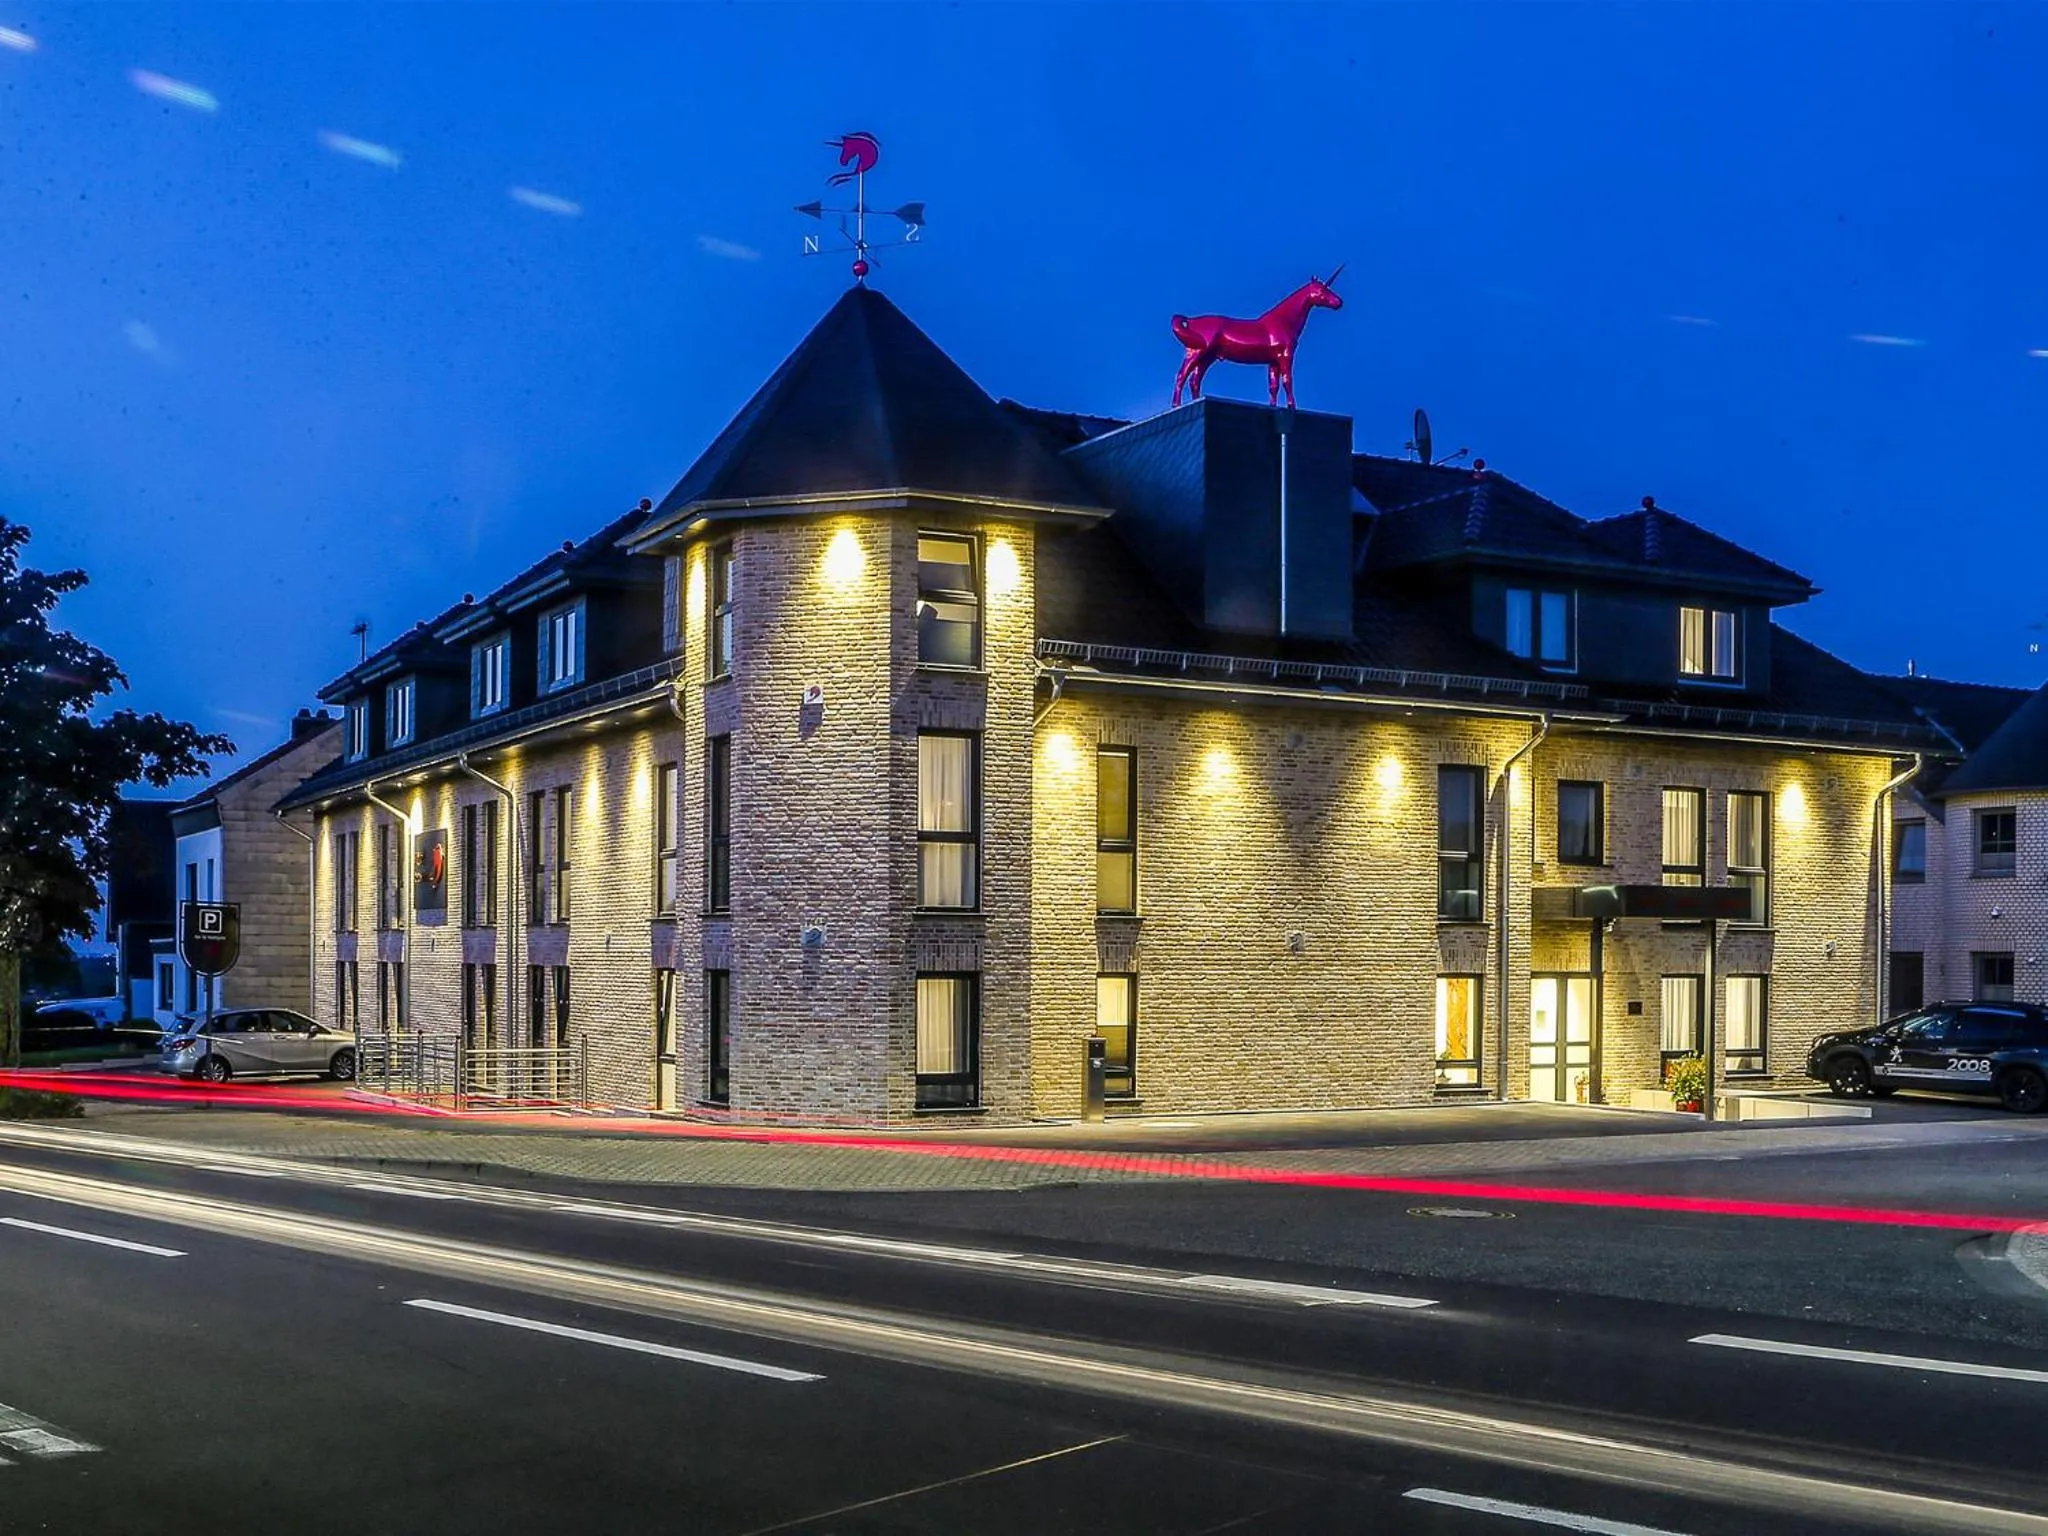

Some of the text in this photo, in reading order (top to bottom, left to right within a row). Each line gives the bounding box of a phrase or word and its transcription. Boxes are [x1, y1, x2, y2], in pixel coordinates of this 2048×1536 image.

[804, 235, 819, 254] N
[2030, 643, 2038, 653] N
[204, 913, 217, 930] P
[1946, 1058, 1991, 1073] 2008
